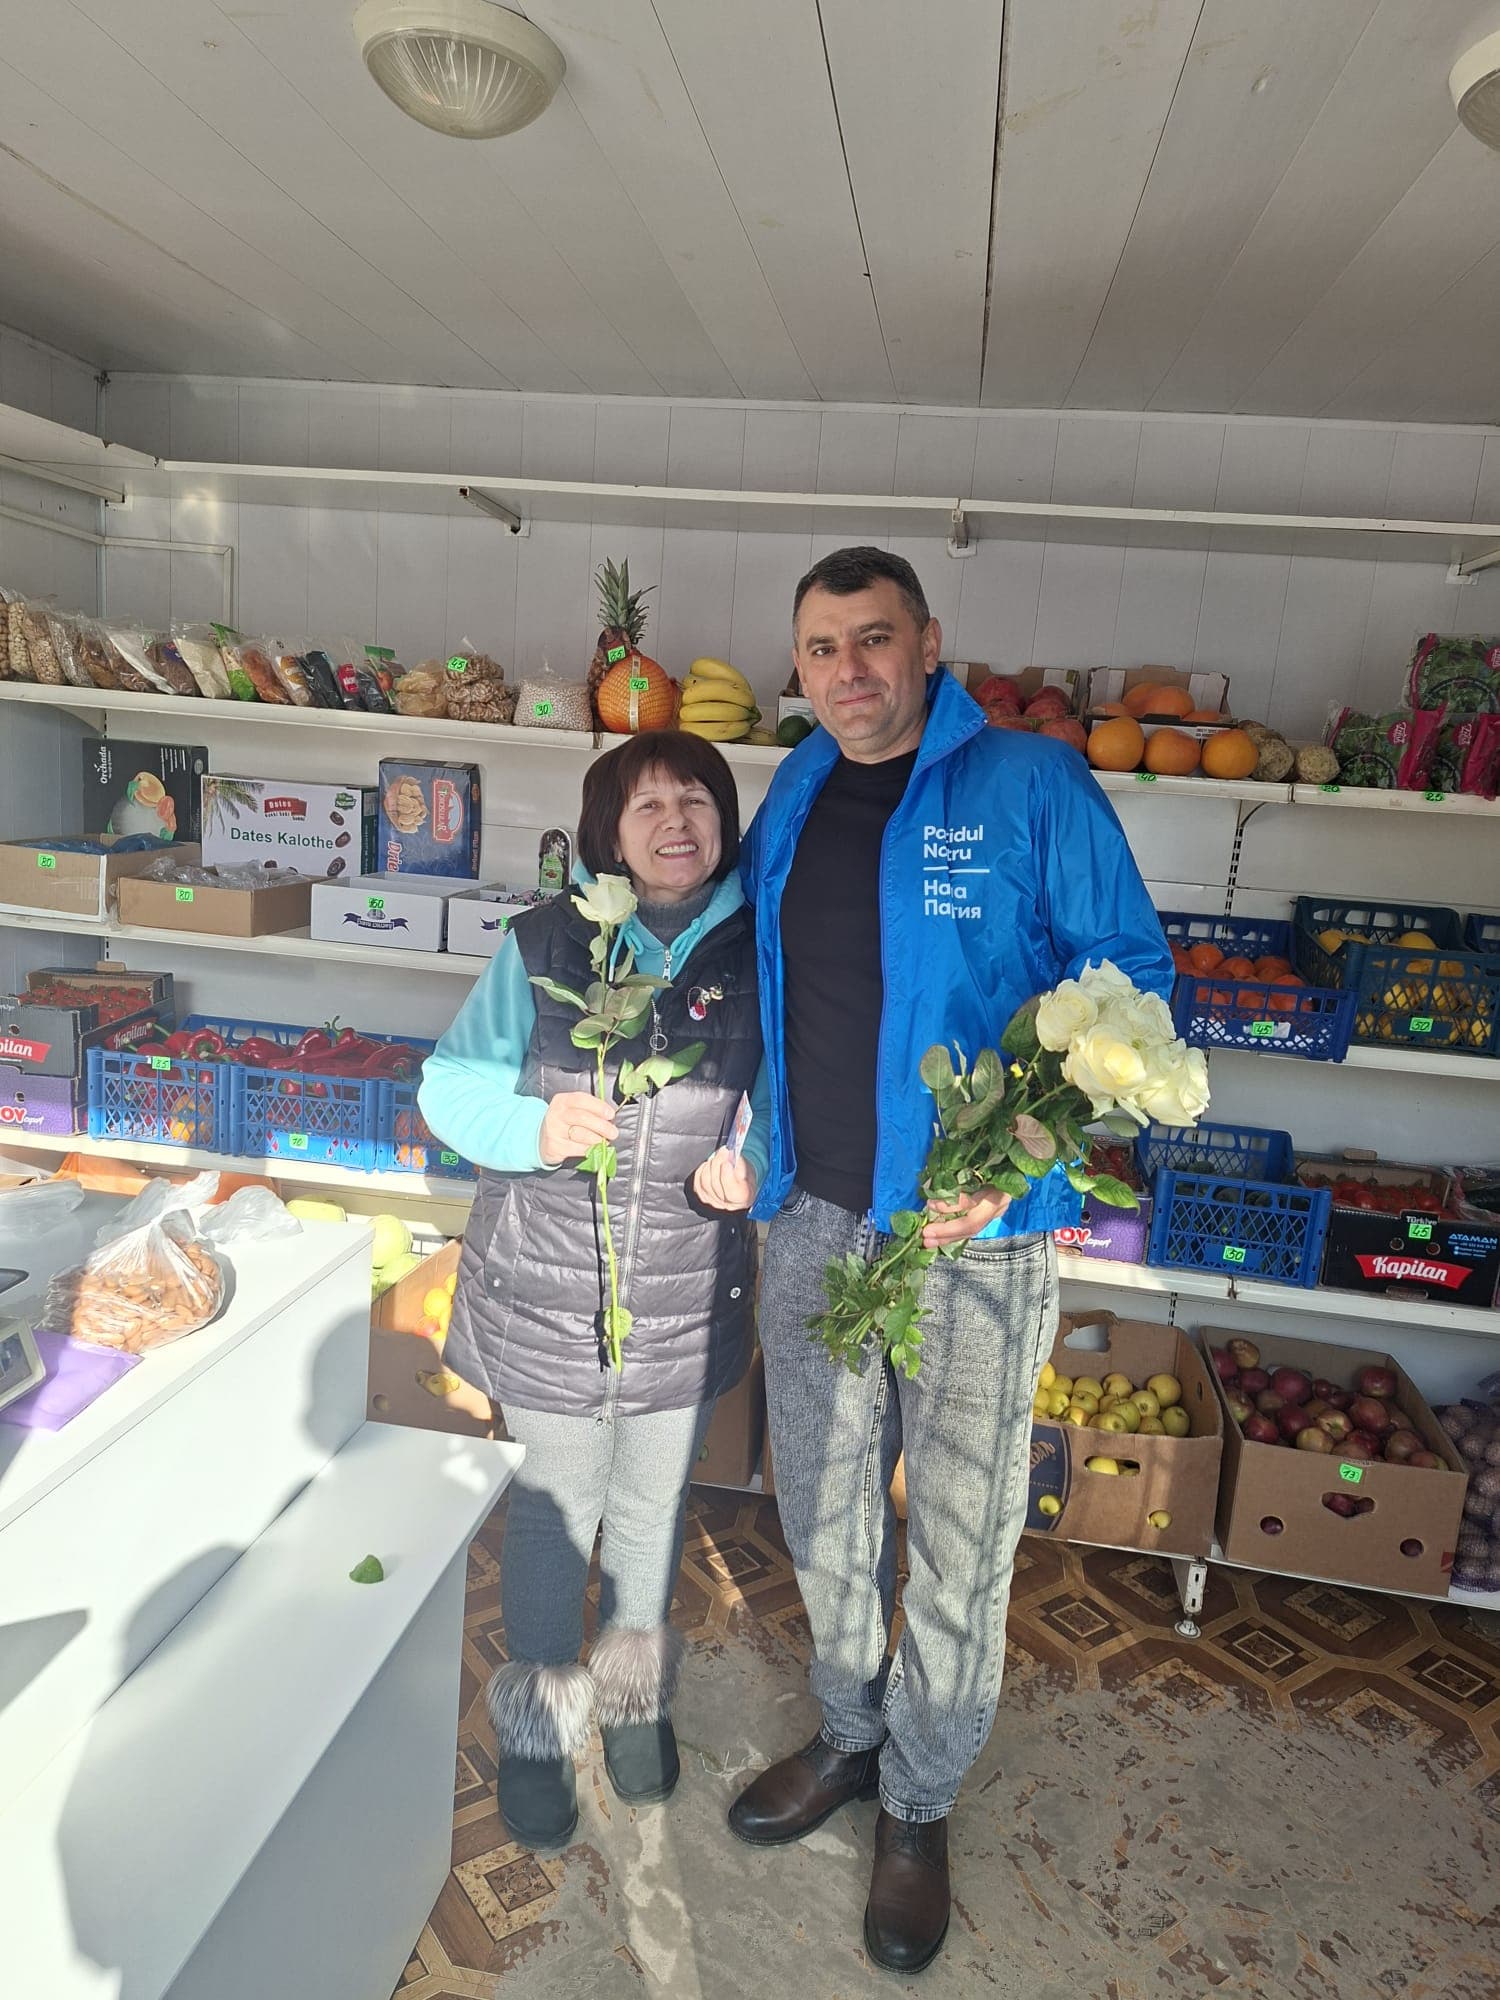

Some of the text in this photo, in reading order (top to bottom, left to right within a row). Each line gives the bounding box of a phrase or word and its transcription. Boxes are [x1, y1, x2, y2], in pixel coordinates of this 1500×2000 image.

[98, 746, 108, 784] Orchada
[230, 827, 334, 849] Dates Kalothe
[386, 840, 402, 872] Drie
[923, 879, 967, 899] Наа
[1412, 1225, 1430, 1237] 45
[1448, 1233, 1498, 1244] ATAMAN
[1372, 1256, 1448, 1282] Kapitan
